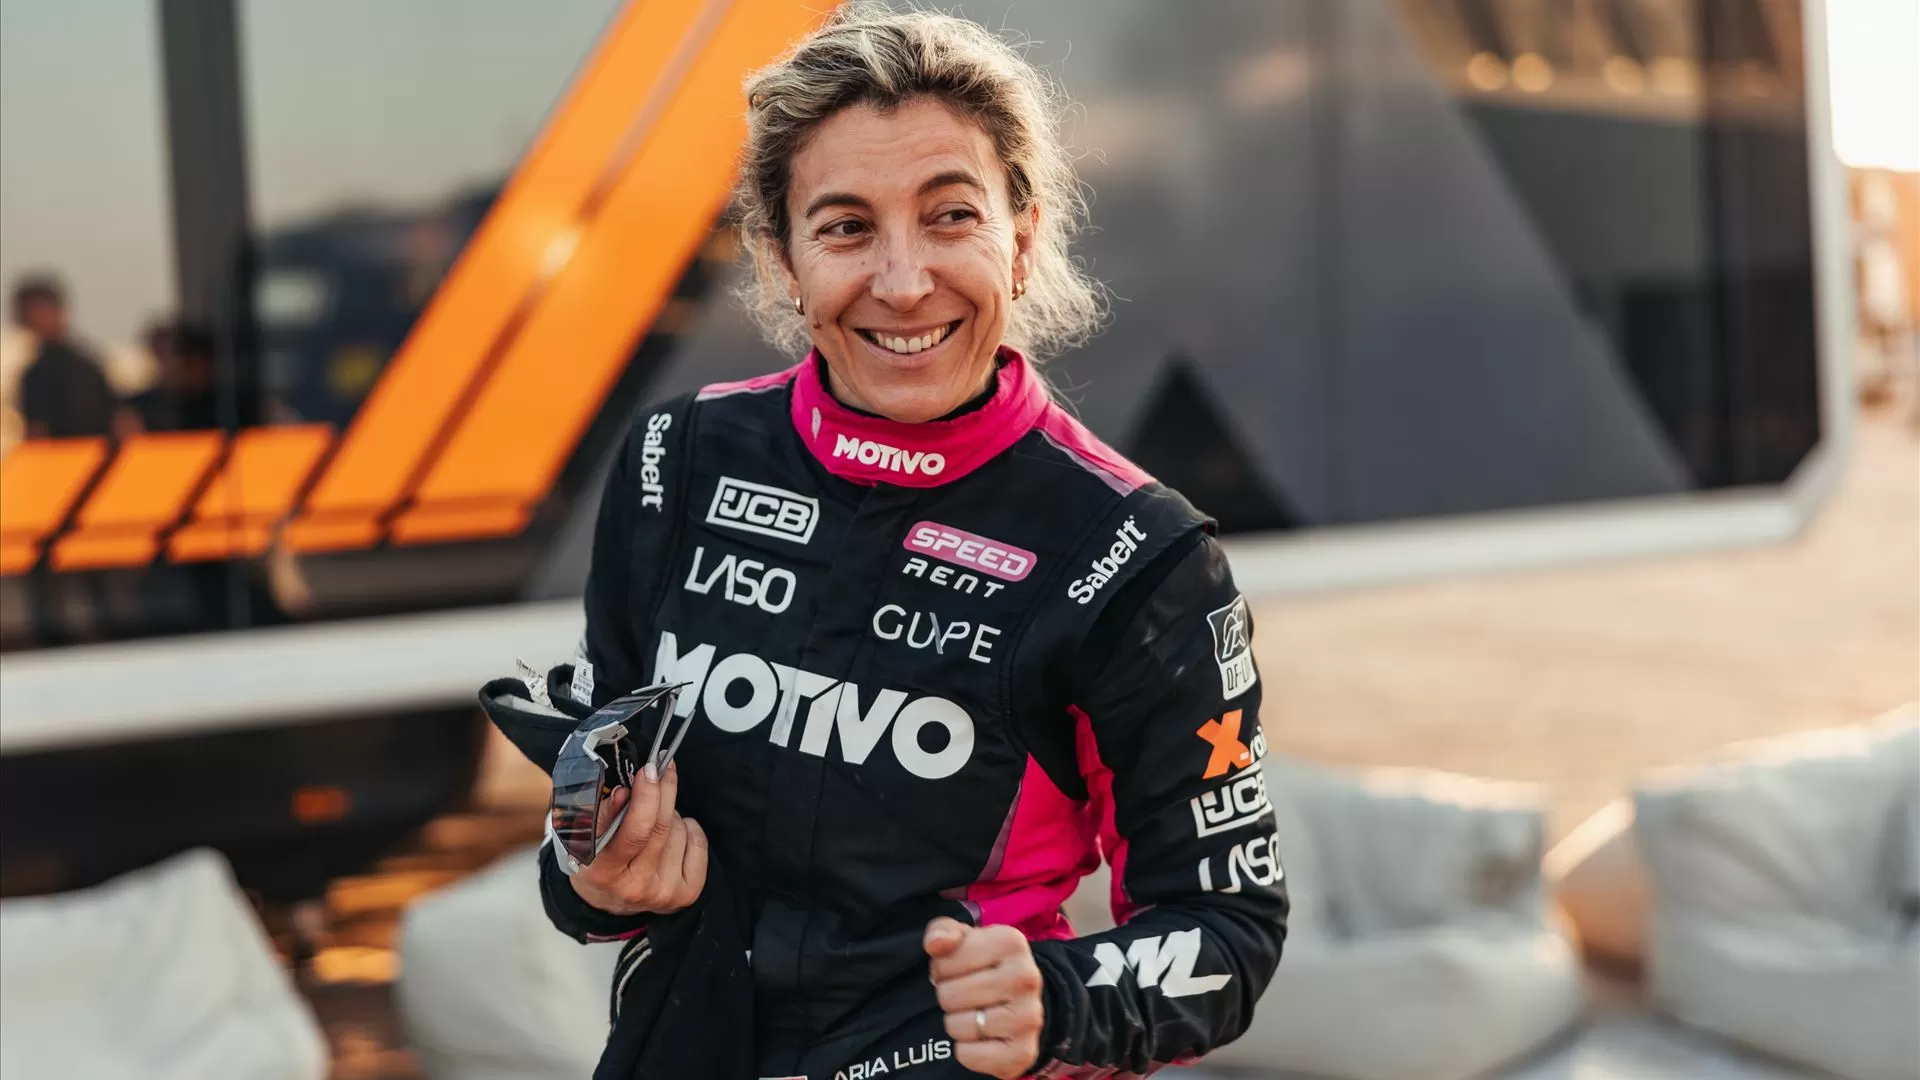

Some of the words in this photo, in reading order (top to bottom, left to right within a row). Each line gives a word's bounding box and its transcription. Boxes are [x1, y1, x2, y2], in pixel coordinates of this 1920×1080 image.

[641, 413, 672, 509] Sabelt
[832, 433, 945, 476] MOTIVO
[718, 487, 811, 533] JCB
[911, 527, 1028, 576] SPEED
[1067, 518, 1147, 605] Sabelt
[684, 546, 797, 614] LASO
[902, 557, 1005, 598] RENT
[651, 630, 975, 780] MOTIVO
[828, 1056, 889, 1080] ARIA
[893, 1038, 952, 1070] LUÍS
